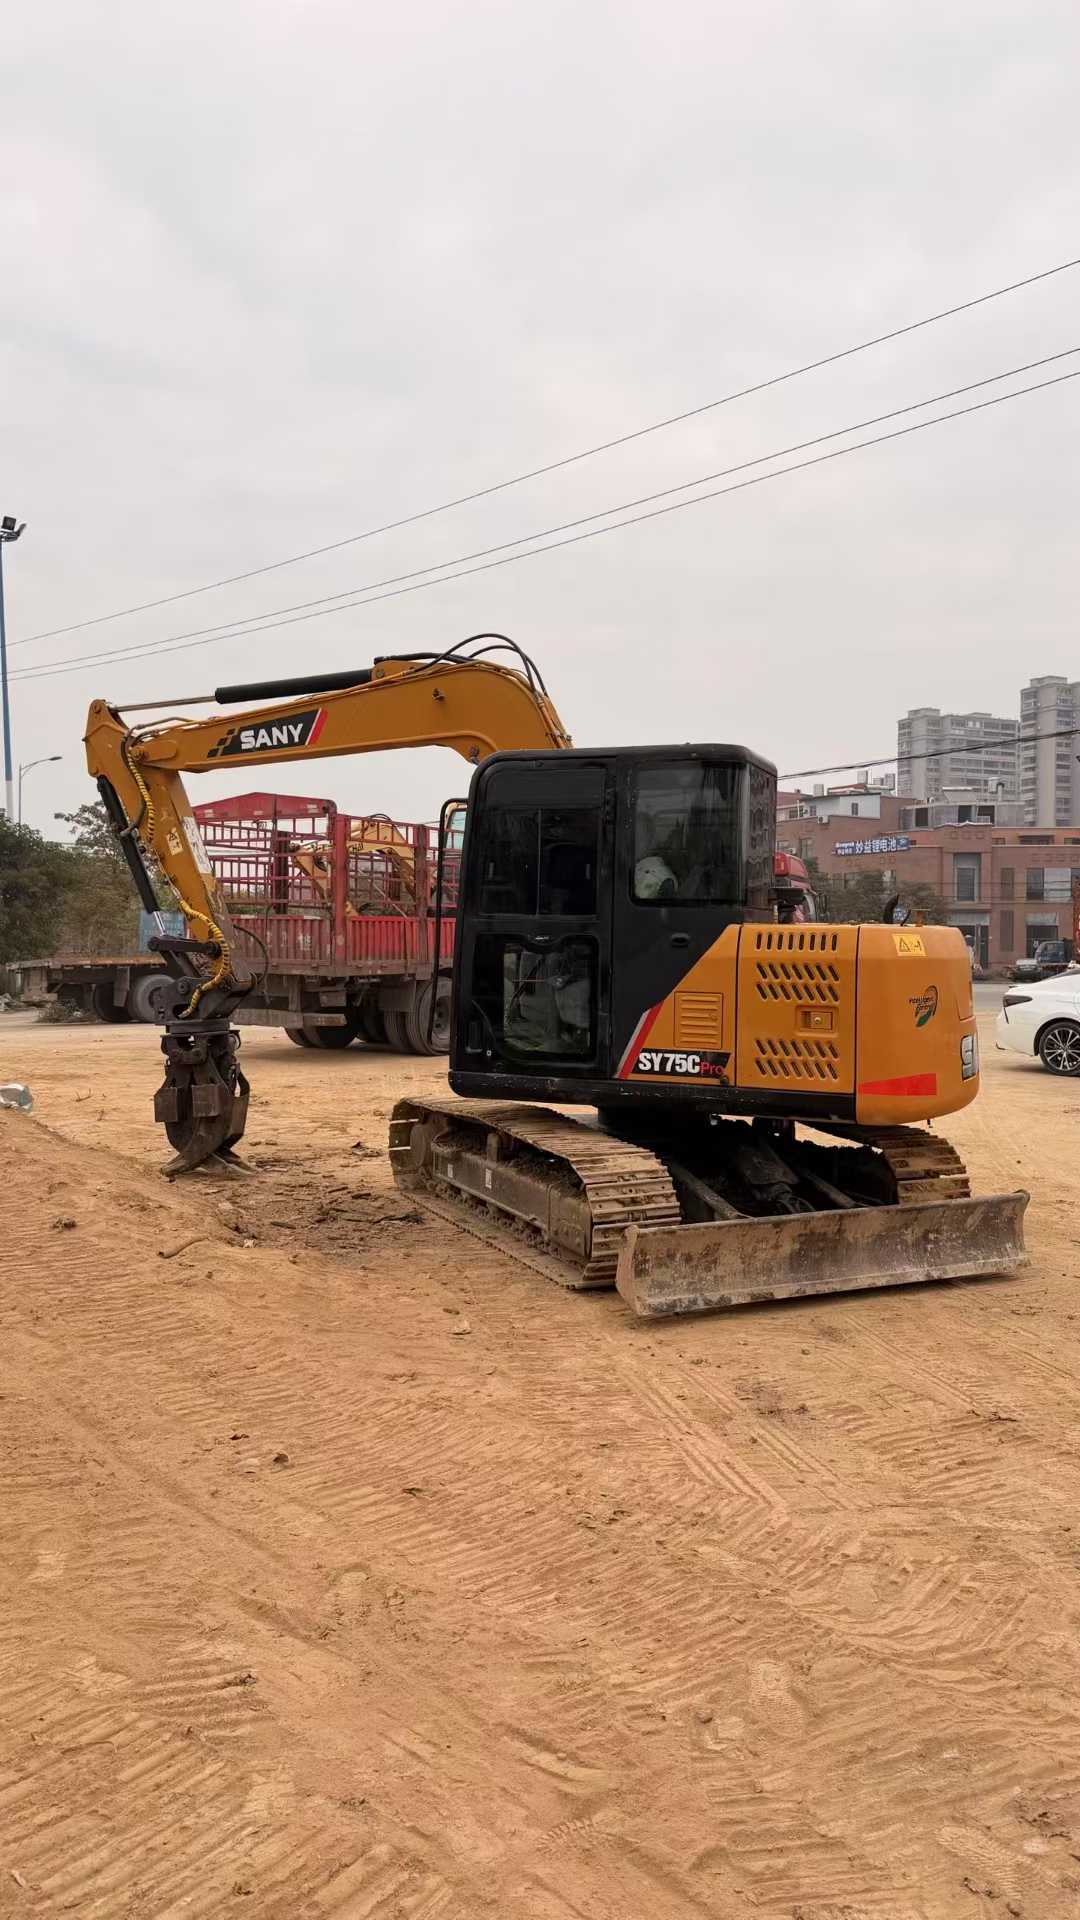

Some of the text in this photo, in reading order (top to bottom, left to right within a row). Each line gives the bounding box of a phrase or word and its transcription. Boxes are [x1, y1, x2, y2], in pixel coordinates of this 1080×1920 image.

[240, 723, 304, 750] SANY
[638, 1052, 725, 1075] SY75C Pro
